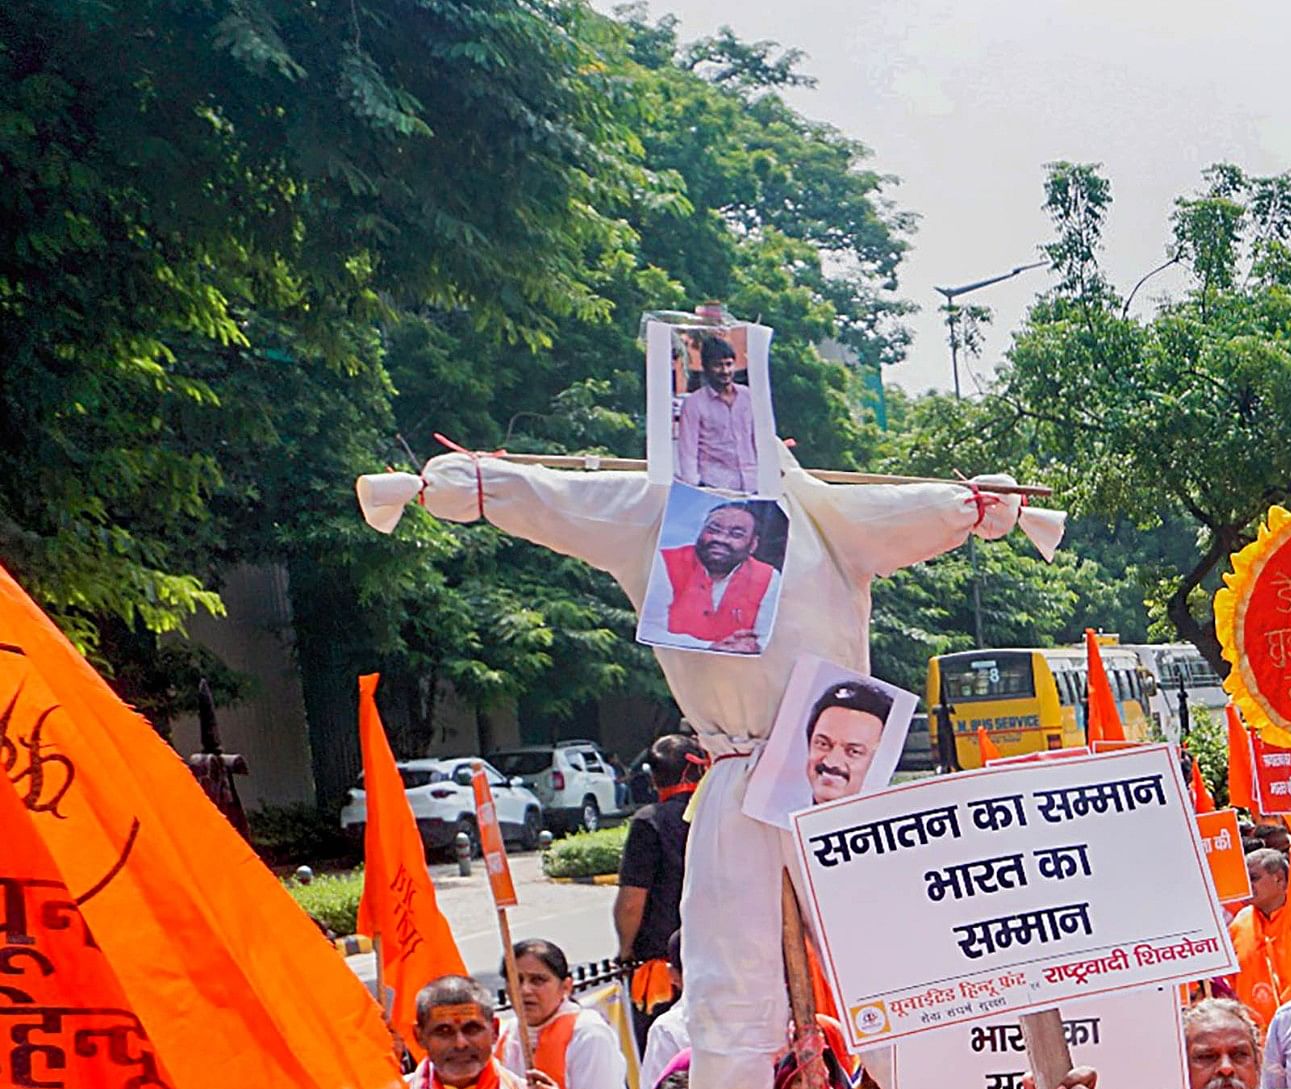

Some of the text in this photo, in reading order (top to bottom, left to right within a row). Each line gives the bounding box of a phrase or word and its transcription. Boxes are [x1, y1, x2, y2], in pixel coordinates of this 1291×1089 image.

[810, 774, 1167, 868] सनातन का सम्मान
[925, 844, 1092, 901] भारत का
[953, 902, 1093, 959] सम्मान
[1043, 948, 1130, 986] राष्ट्रवादी
[1133, 936, 1220, 968] शिवसेना
[971, 1024, 1025, 1054] भार
